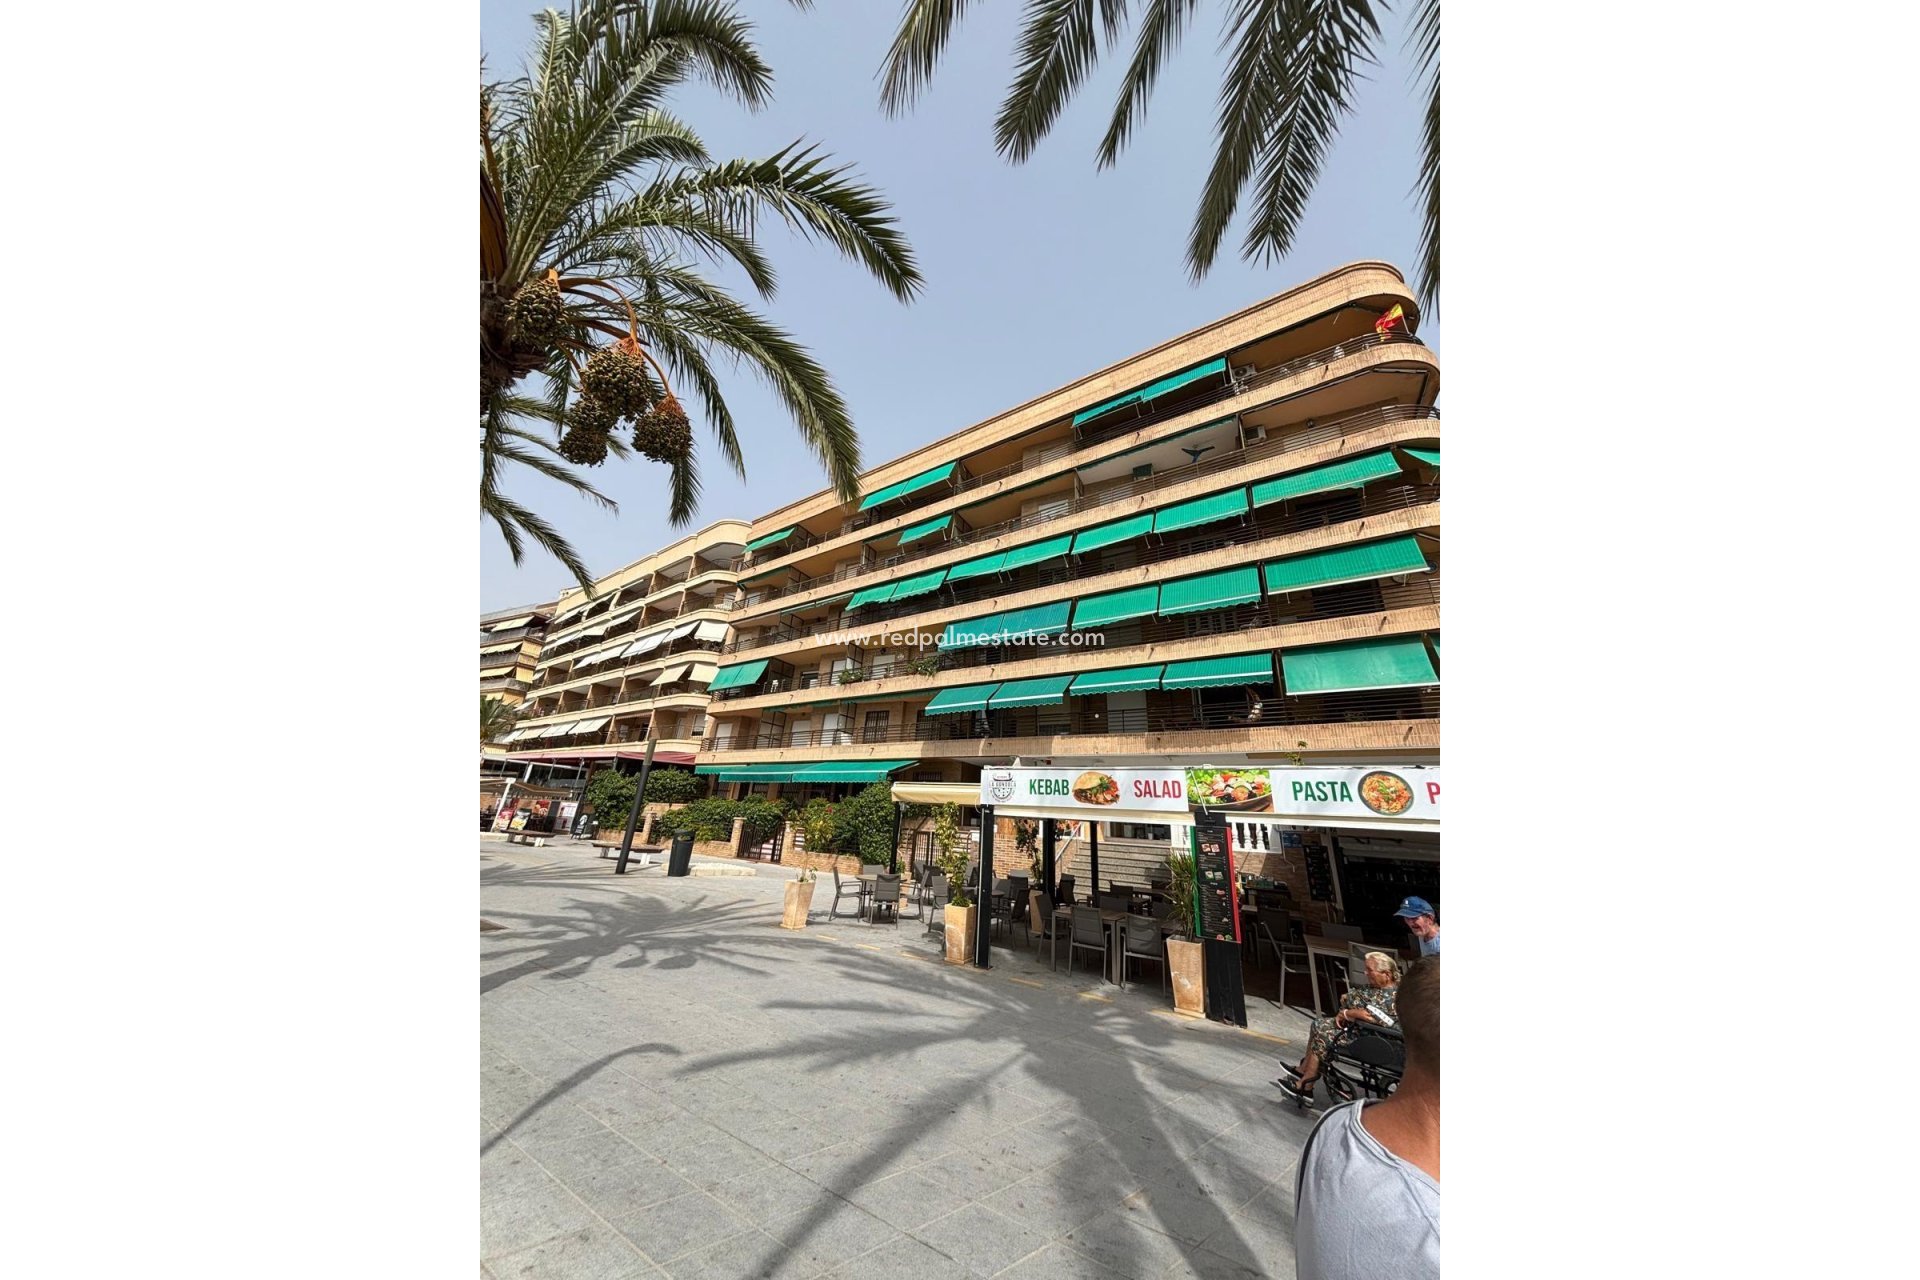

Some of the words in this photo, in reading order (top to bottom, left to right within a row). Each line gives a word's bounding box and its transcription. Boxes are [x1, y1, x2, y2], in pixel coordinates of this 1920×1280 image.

[1029, 778, 1070, 796] KEBAB
[1134, 779, 1182, 799] SALAD
[1291, 780, 1353, 802] PASTA
